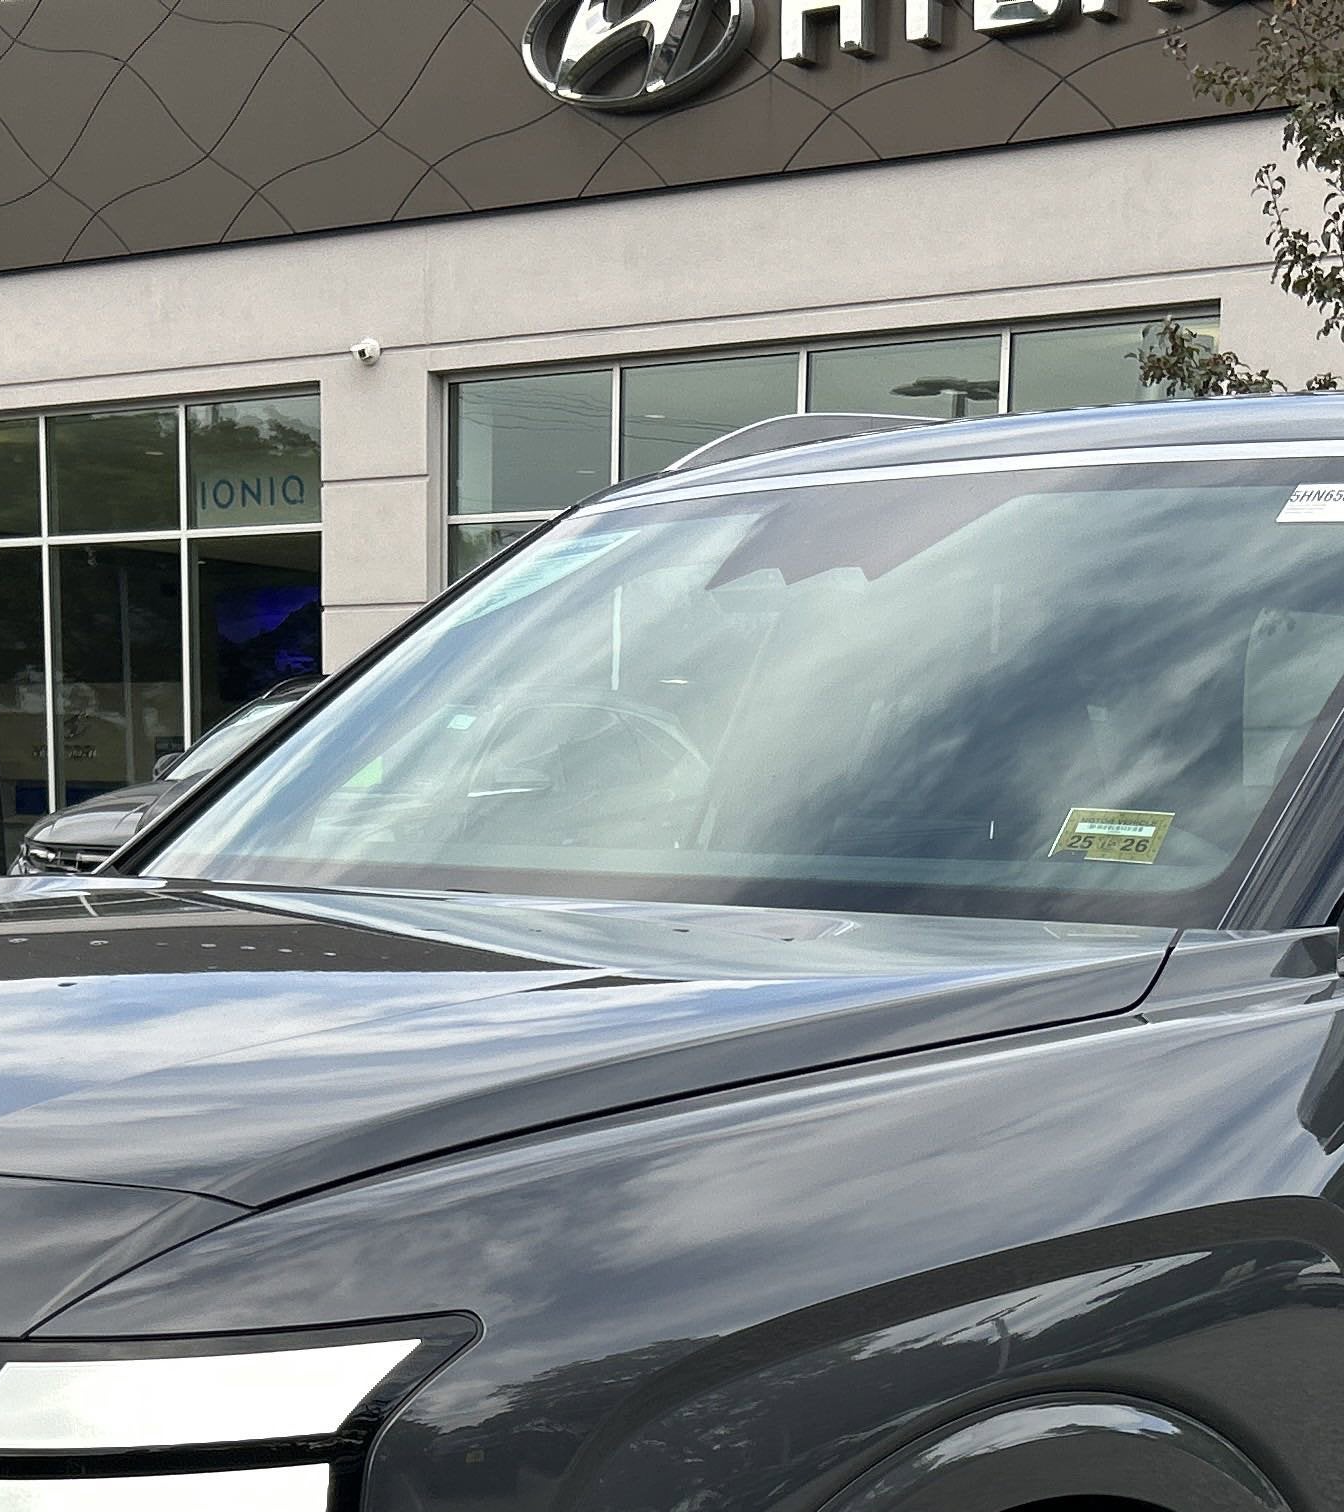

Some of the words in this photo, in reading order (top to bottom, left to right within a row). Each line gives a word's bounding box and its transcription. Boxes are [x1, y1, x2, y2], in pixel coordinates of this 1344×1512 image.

[201, 475, 305, 510] IONIQ
[1067, 835, 1095, 849] 25
[1120, 838, 1150, 853] 26
